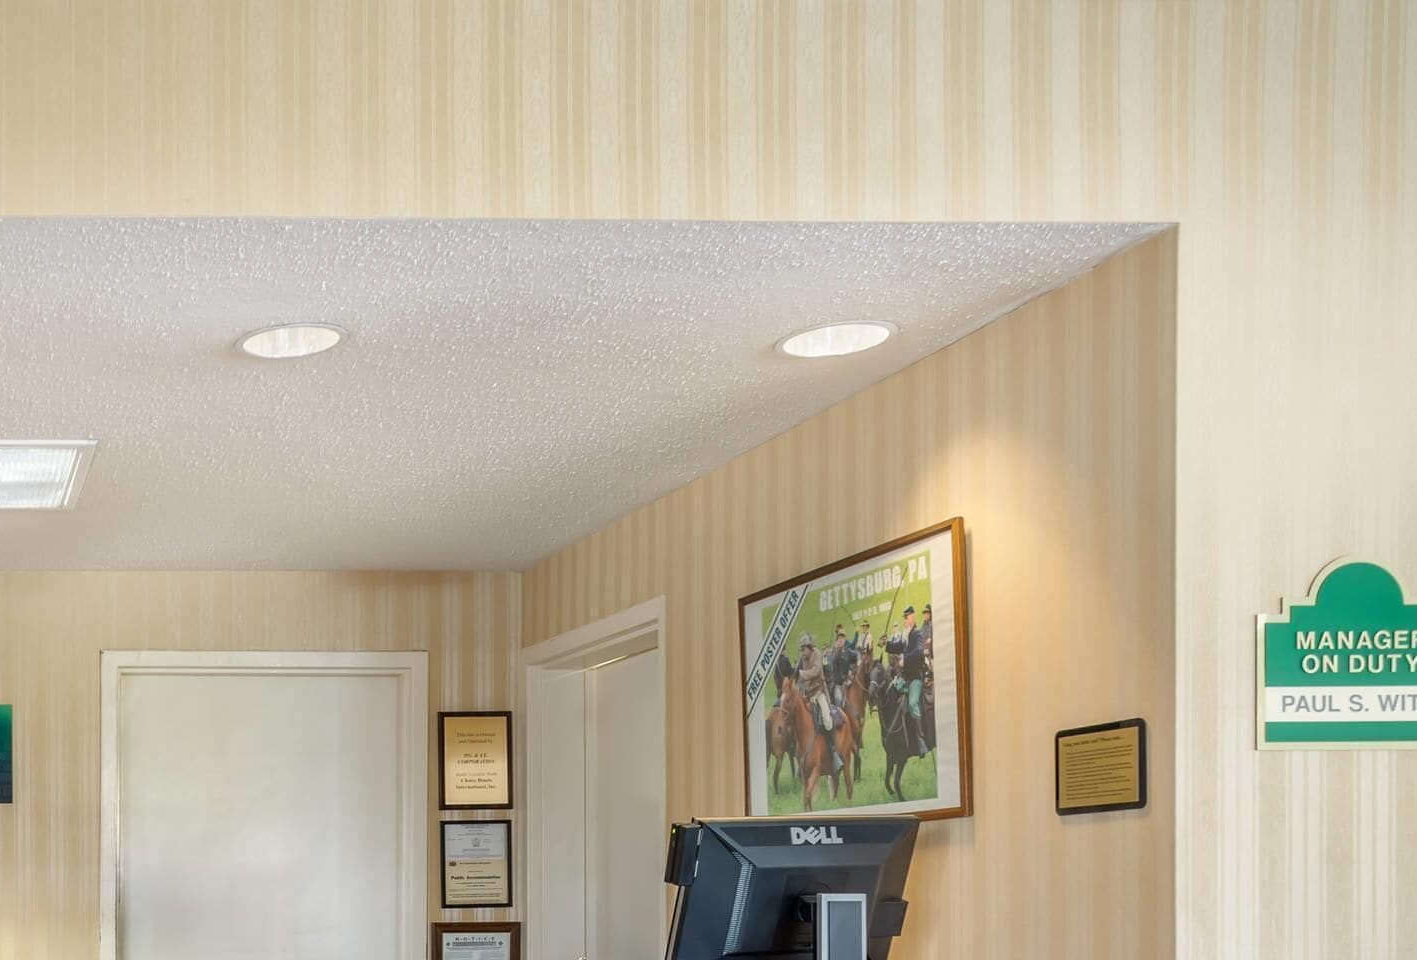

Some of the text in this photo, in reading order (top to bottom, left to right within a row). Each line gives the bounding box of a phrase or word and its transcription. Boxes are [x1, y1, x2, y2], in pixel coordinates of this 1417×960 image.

[907, 556, 928, 584] PA
[747, 589, 800, 702] FREE POSTER OFFER
[1302, 653, 1417, 674] ON DUTY
[1282, 695, 1341, 713] PAUL
[1349, 694, 1370, 713] S.
[789, 825, 844, 845] DELL
